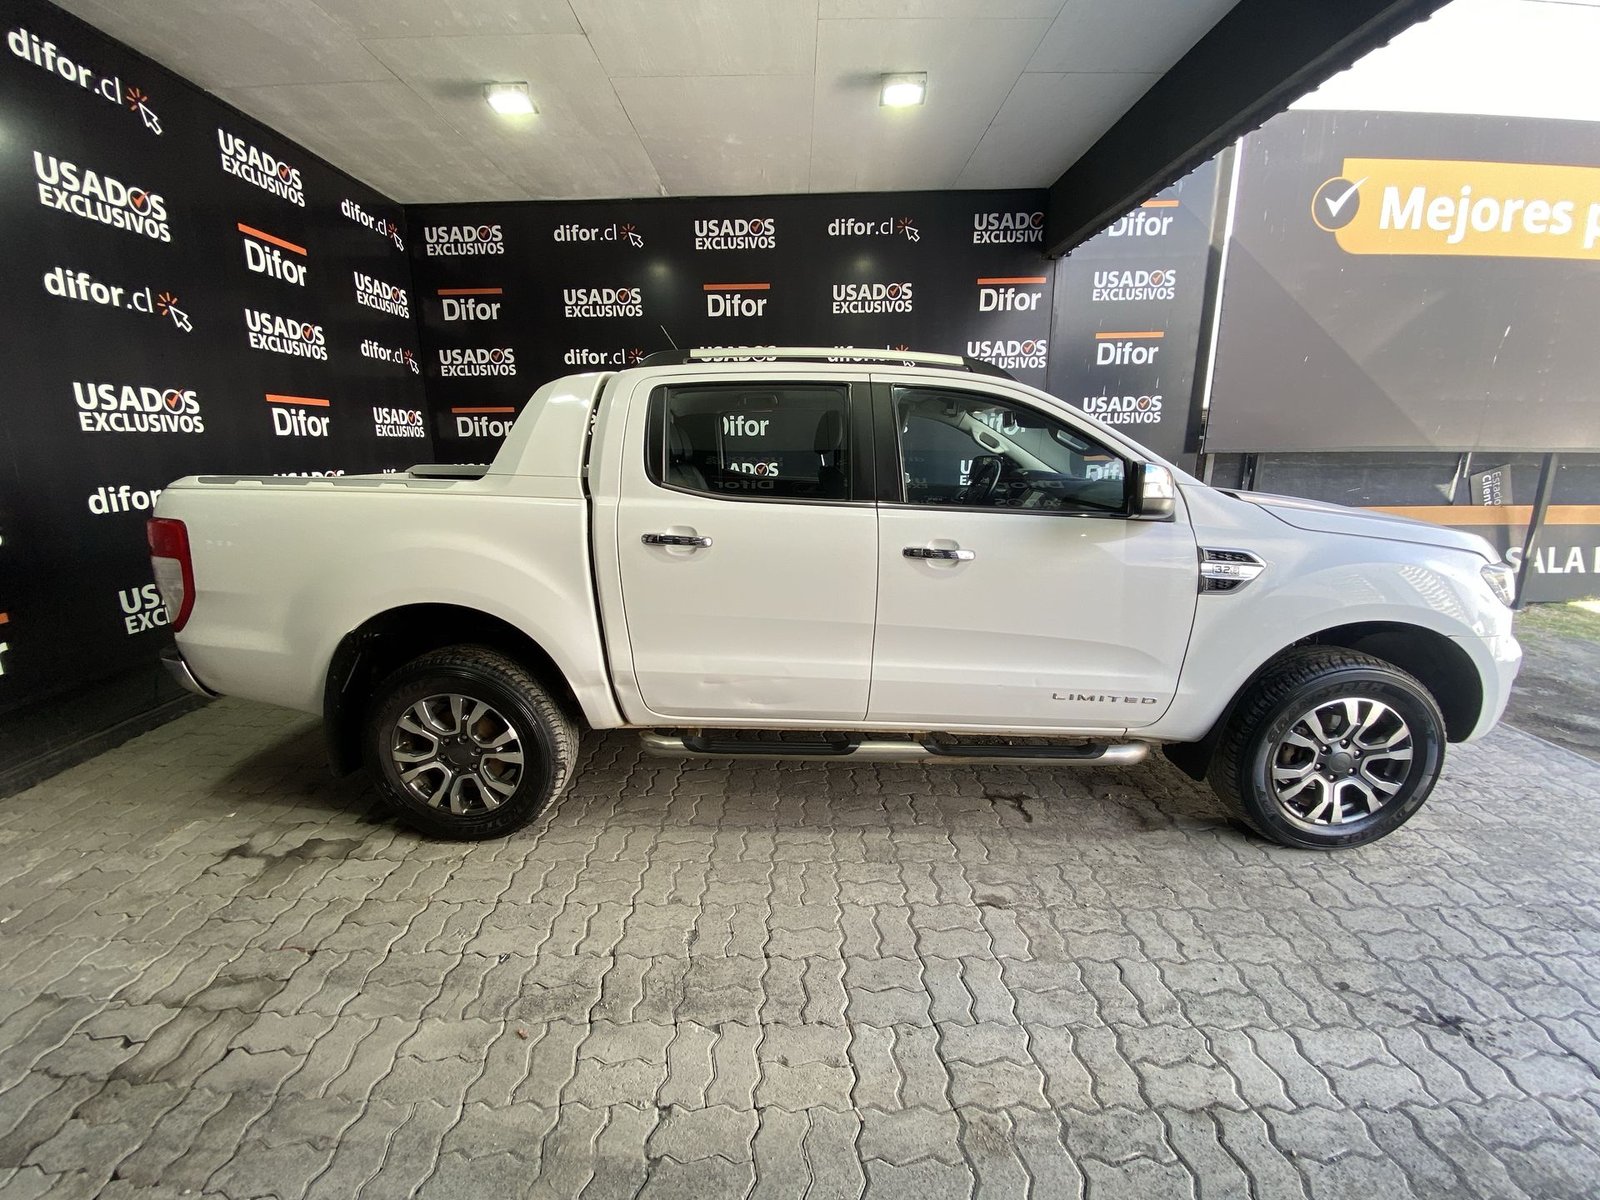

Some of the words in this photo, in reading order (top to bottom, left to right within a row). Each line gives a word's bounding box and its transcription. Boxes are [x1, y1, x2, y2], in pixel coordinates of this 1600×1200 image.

[8, 28, 122, 105] difor.cl
[218, 128, 303, 190] USADOS
[34, 151, 168, 221] USADOS
[221, 153, 305, 208] EXCLUSIVOS
[38, 183, 171, 242] EXCLUSIVOS
[340, 199, 388, 236] difor.cl
[1379, 185, 1574, 244] Mejores
[424, 225, 503, 243] USADOS
[553, 223, 617, 242] difor.cl
[694, 218, 775, 237] USADOS
[828, 217, 893, 236] difor.cl
[426, 241, 505, 256] EXCLUSIVOS
[695, 236, 776, 250] EXCLUSIVOS
[244, 238, 307, 287] Difor
[353, 271, 408, 306] USADOS
[1093, 269, 1176, 288] USADOS
[44, 267, 154, 313] difor.cl
[563, 287, 642, 305] USADOS
[833, 282, 913, 301] USADOS
[979, 287, 1042, 312] Difor
[1092, 286, 1175, 301] EXCLUSIVOS
[356, 290, 410, 319] EXCLUSIVOS
[442, 298, 501, 321] Difor
[565, 305, 643, 318] EXCLUSIVOS
[707, 293, 767, 317] Difor
[832, 300, 913, 314] EXCLUSIVOS
[245, 308, 325, 346] USADOS
[249, 331, 328, 361] EXCLUSIVOS
[360, 339, 404, 364] difor.cl
[439, 348, 515, 365] USADOS
[967, 340, 1047, 357] USADOS
[1096, 342, 1159, 365] Difor
[564, 349, 626, 365] difor.cl
[441, 364, 517, 377] EXCLUSIVOS
[73, 382, 200, 415] USADOS
[1083, 395, 1163, 413] USADOS
[79, 412, 205, 433] EXCLUSIVOS
[271, 407, 330, 437] Difor
[372, 406, 423, 427] USADOS
[1088, 412, 1162, 425] XCLUSIVOS
[375, 424, 425, 438] EXCLUSIVOS
[1505, 546, 1586, 574] SALA
[1052, 693, 1157, 705] LIMITED
